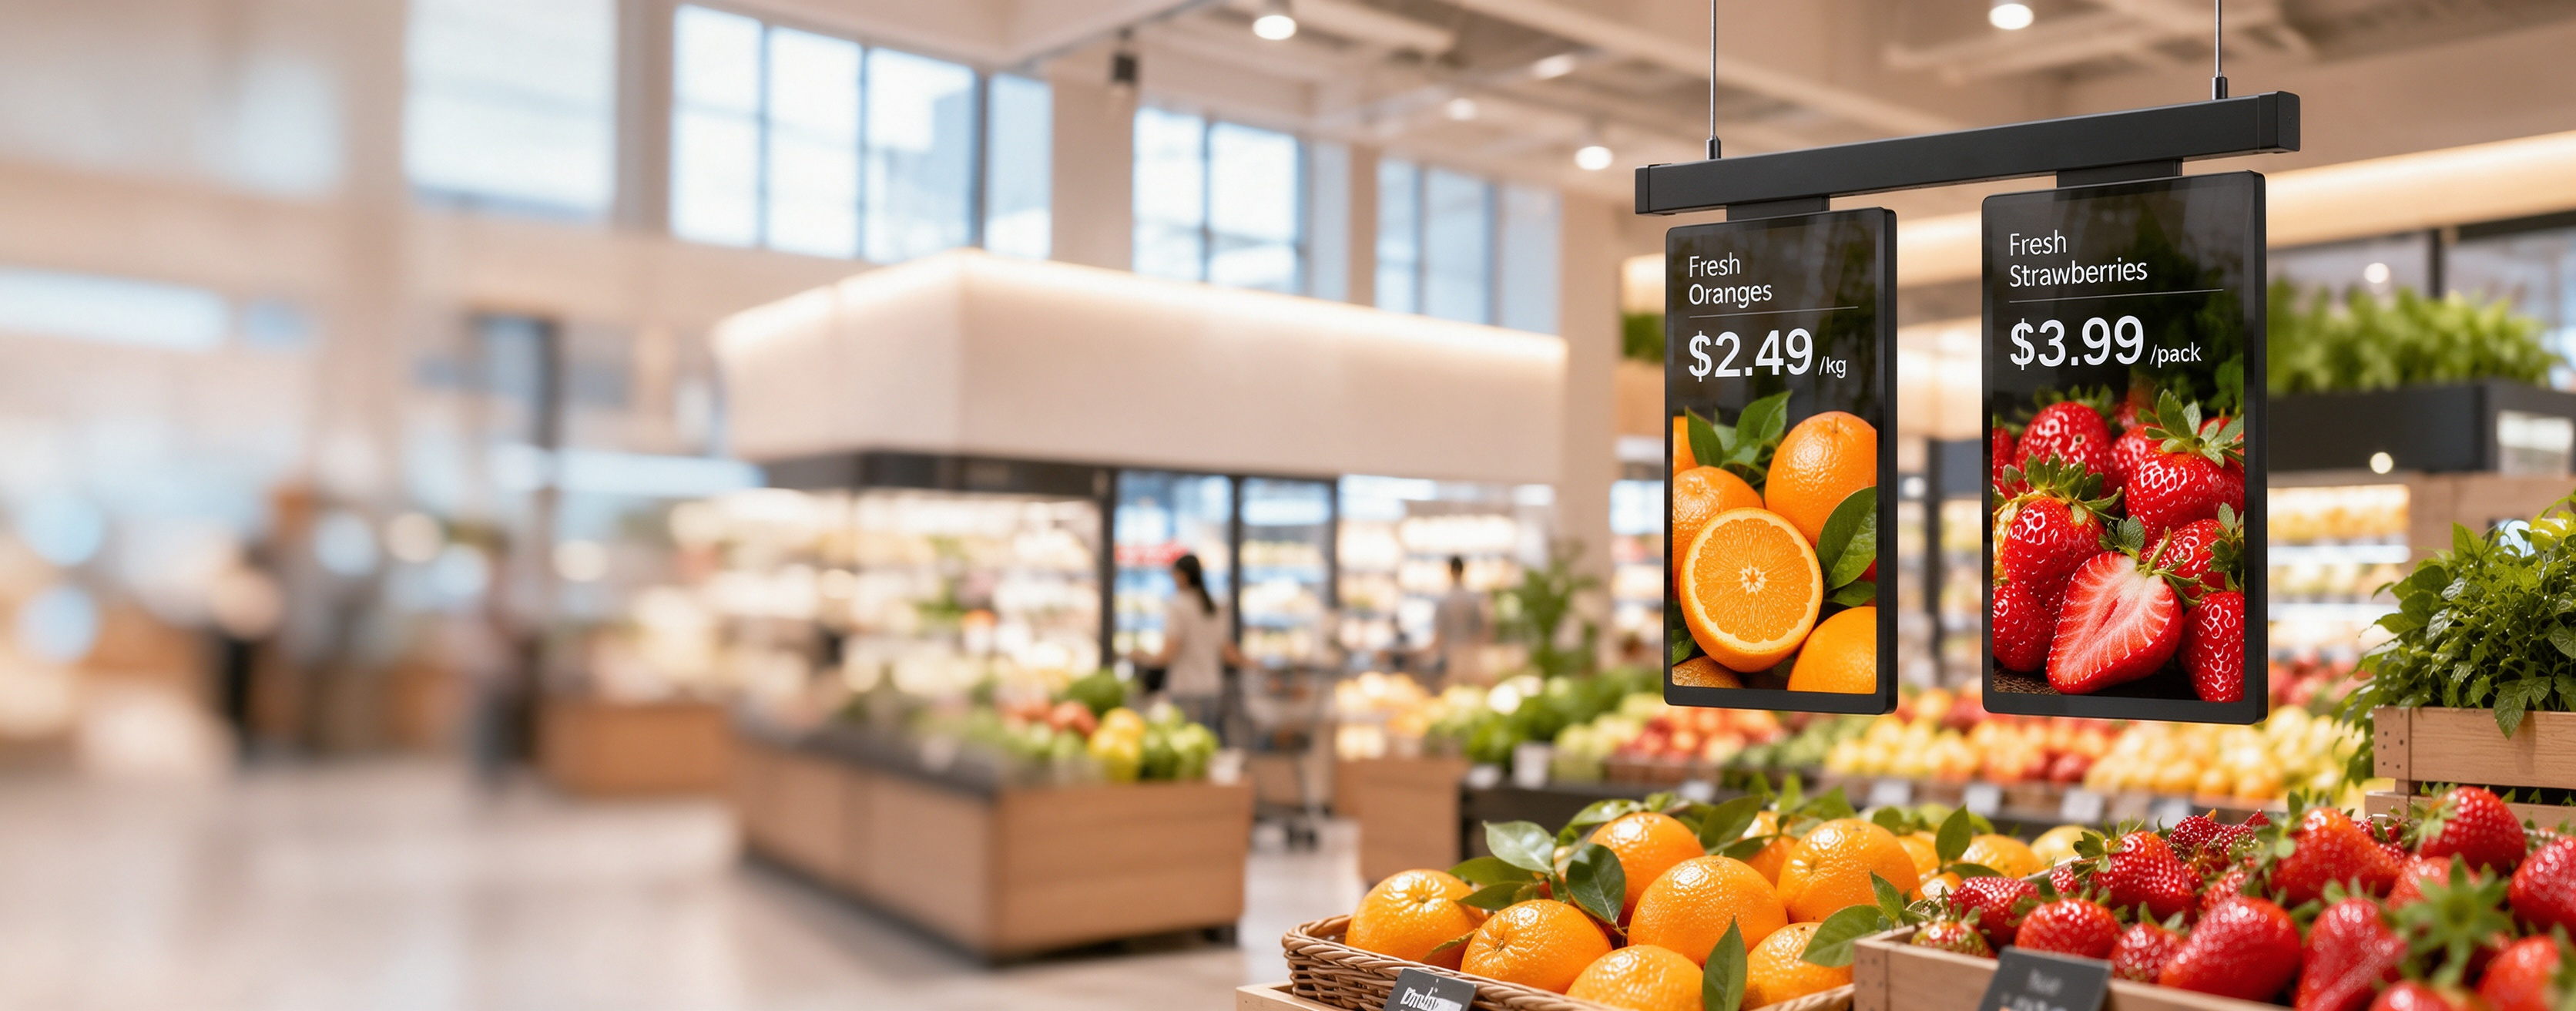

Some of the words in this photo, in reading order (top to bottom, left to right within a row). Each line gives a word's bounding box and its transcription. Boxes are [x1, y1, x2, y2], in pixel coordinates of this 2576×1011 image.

[2010, 230, 2067, 257] Fresh
[1689, 251, 1740, 277] Fresh
[2009, 257, 2148, 287] Strawberries
[1689, 283, 1773, 309] Oranges
[1689, 328, 1813, 382] $2.49
[1819, 355, 1846, 378] /kg
[2010, 315, 2144, 371] $3.99
[2149, 341, 2202, 368] /pack
